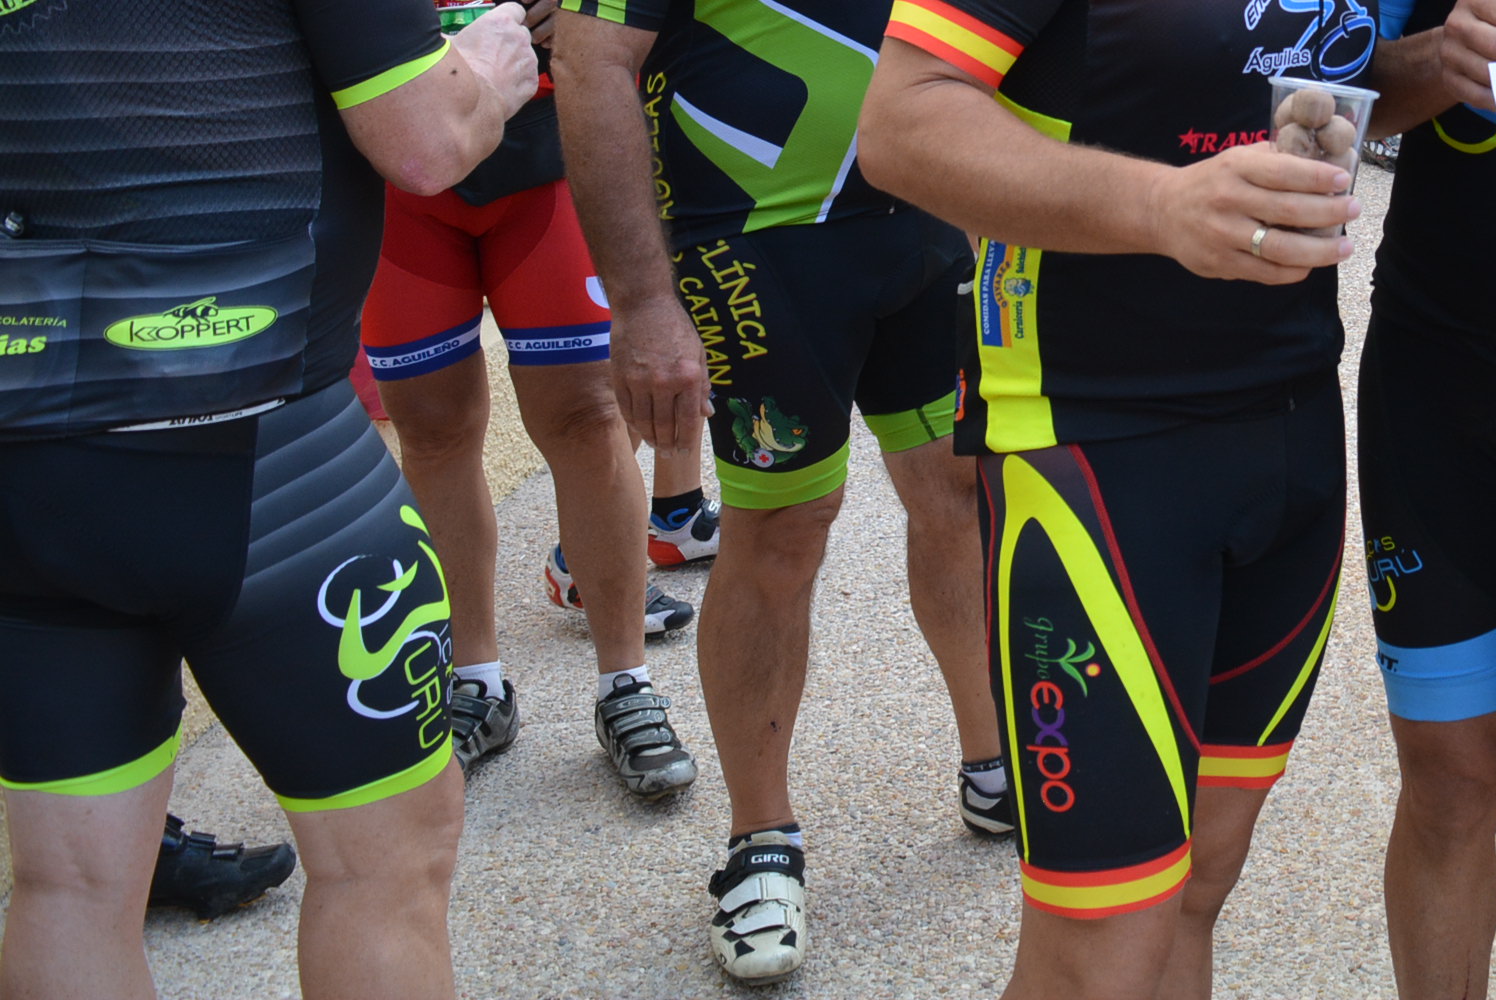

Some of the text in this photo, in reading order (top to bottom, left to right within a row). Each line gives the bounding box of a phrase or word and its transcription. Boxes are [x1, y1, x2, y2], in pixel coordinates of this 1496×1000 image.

[982, 269, 991, 291] PARA
[982, 291, 991, 335] COMIDAS
[129, 314, 255, 343] KOPPERT
[680, 277, 733, 385] CAIMAN
[392, 338, 460, 367] AGUILEÑO
[525, 337, 593, 350] AGUILEÑO
[1026, 680, 1076, 813] expo
[750, 853, 790, 865] GIRO
